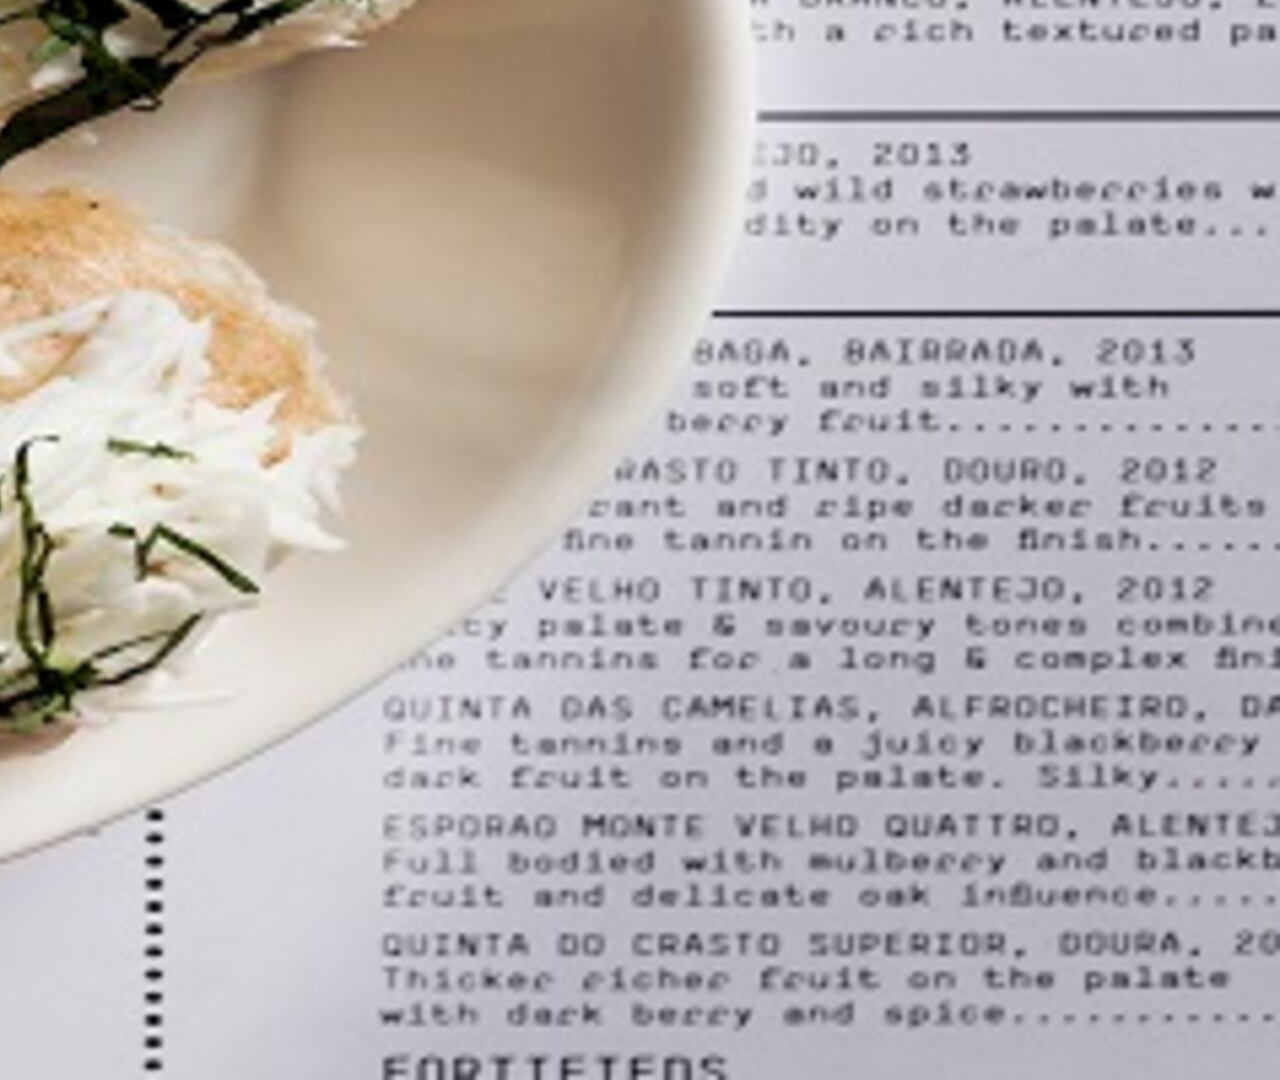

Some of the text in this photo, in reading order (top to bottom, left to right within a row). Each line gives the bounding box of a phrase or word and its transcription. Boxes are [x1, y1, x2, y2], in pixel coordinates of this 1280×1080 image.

[692, 373, 1170, 404] soft and silky with
[381, 694, 533, 724] QUINTA
[559, 694, 634, 723] DAS
[383, 727, 1260, 763] Fine tannins and a juicy blackberry
[383, 964, 1230, 995] Thicker richer fruit on the palate
